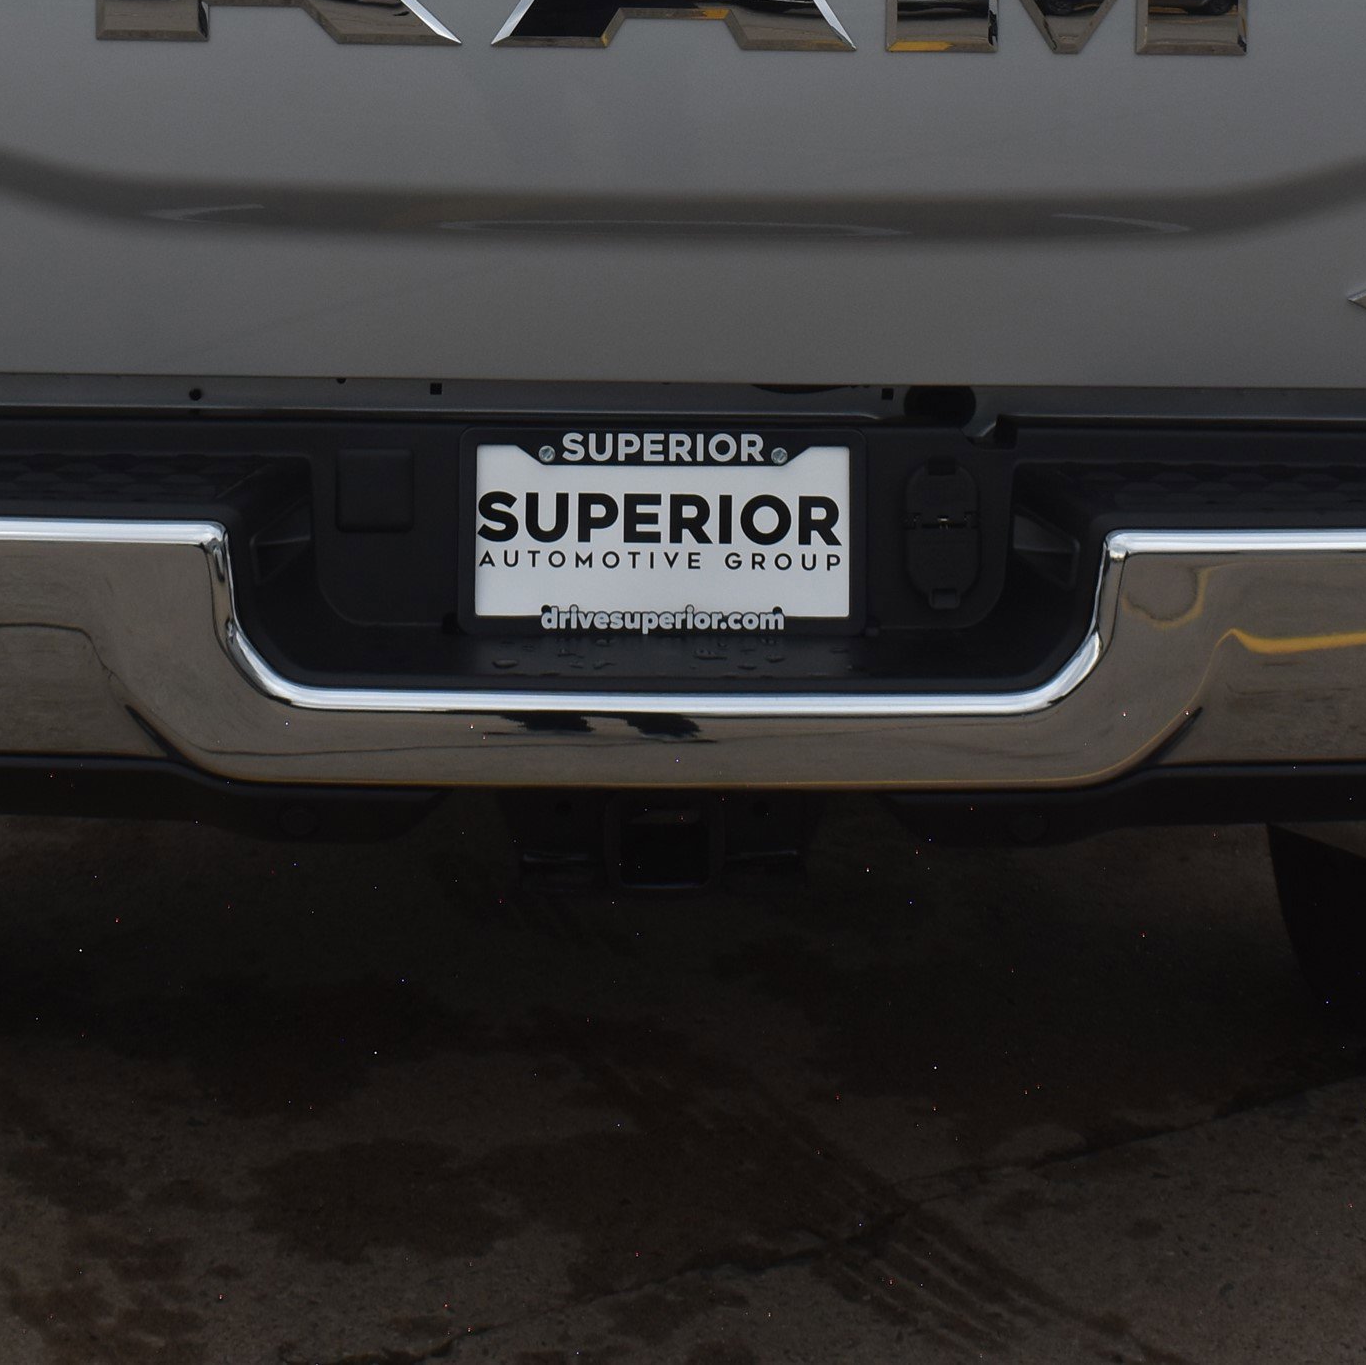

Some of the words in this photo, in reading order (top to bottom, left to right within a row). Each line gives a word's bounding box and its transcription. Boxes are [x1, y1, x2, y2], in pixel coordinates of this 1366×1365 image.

[561, 432, 765, 463] SUPERIOR
[477, 490, 842, 546] SUPERIOR
[478, 549, 702, 570] AUTOMOTIVE
[724, 551, 841, 572] GROUP
[541, 605, 785, 633] drivesuperior.com
